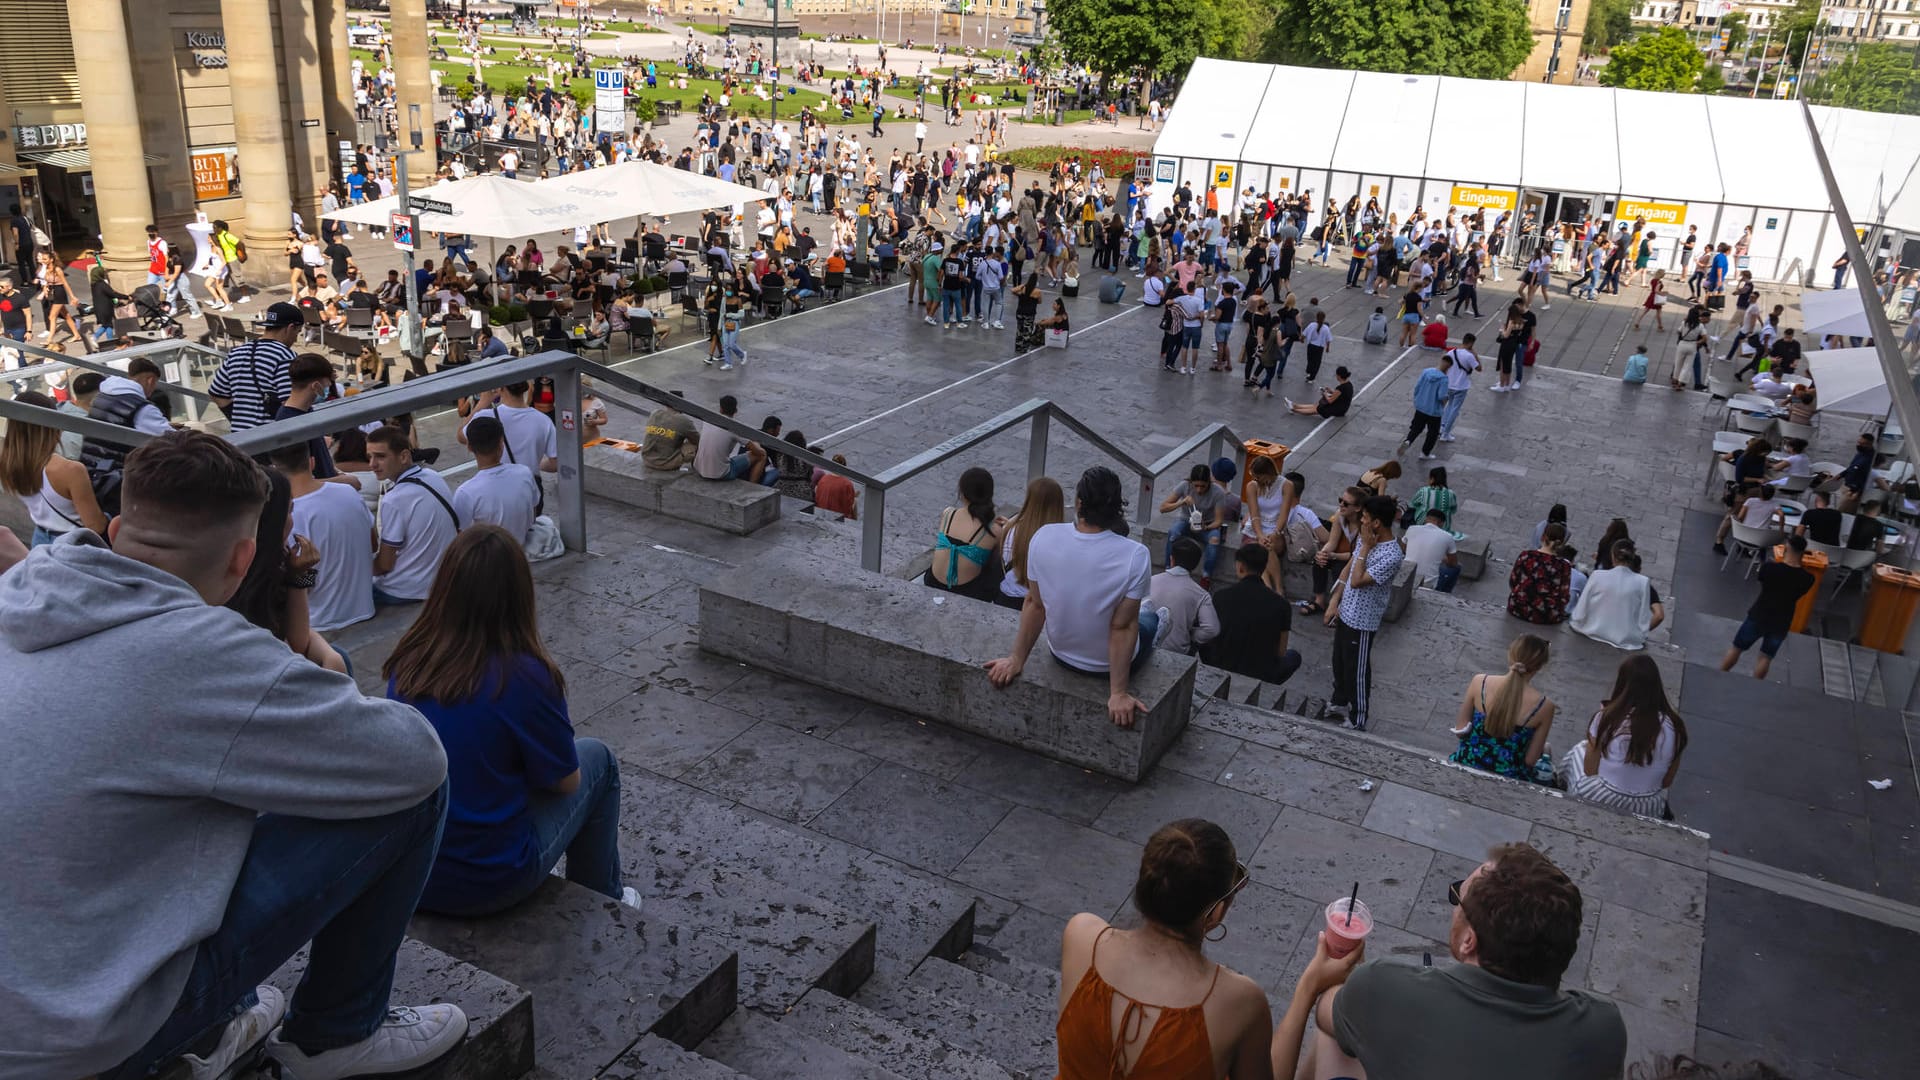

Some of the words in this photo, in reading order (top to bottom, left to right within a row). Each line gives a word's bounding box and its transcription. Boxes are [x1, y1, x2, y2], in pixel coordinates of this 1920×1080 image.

[598, 71, 608, 84] U
[613, 71, 622, 85] U
[193, 157, 221, 171] BUY
[194, 171, 225, 185] SELL
[1459, 190, 1508, 208] Eingang
[1625, 204, 1677, 222] Eingang
